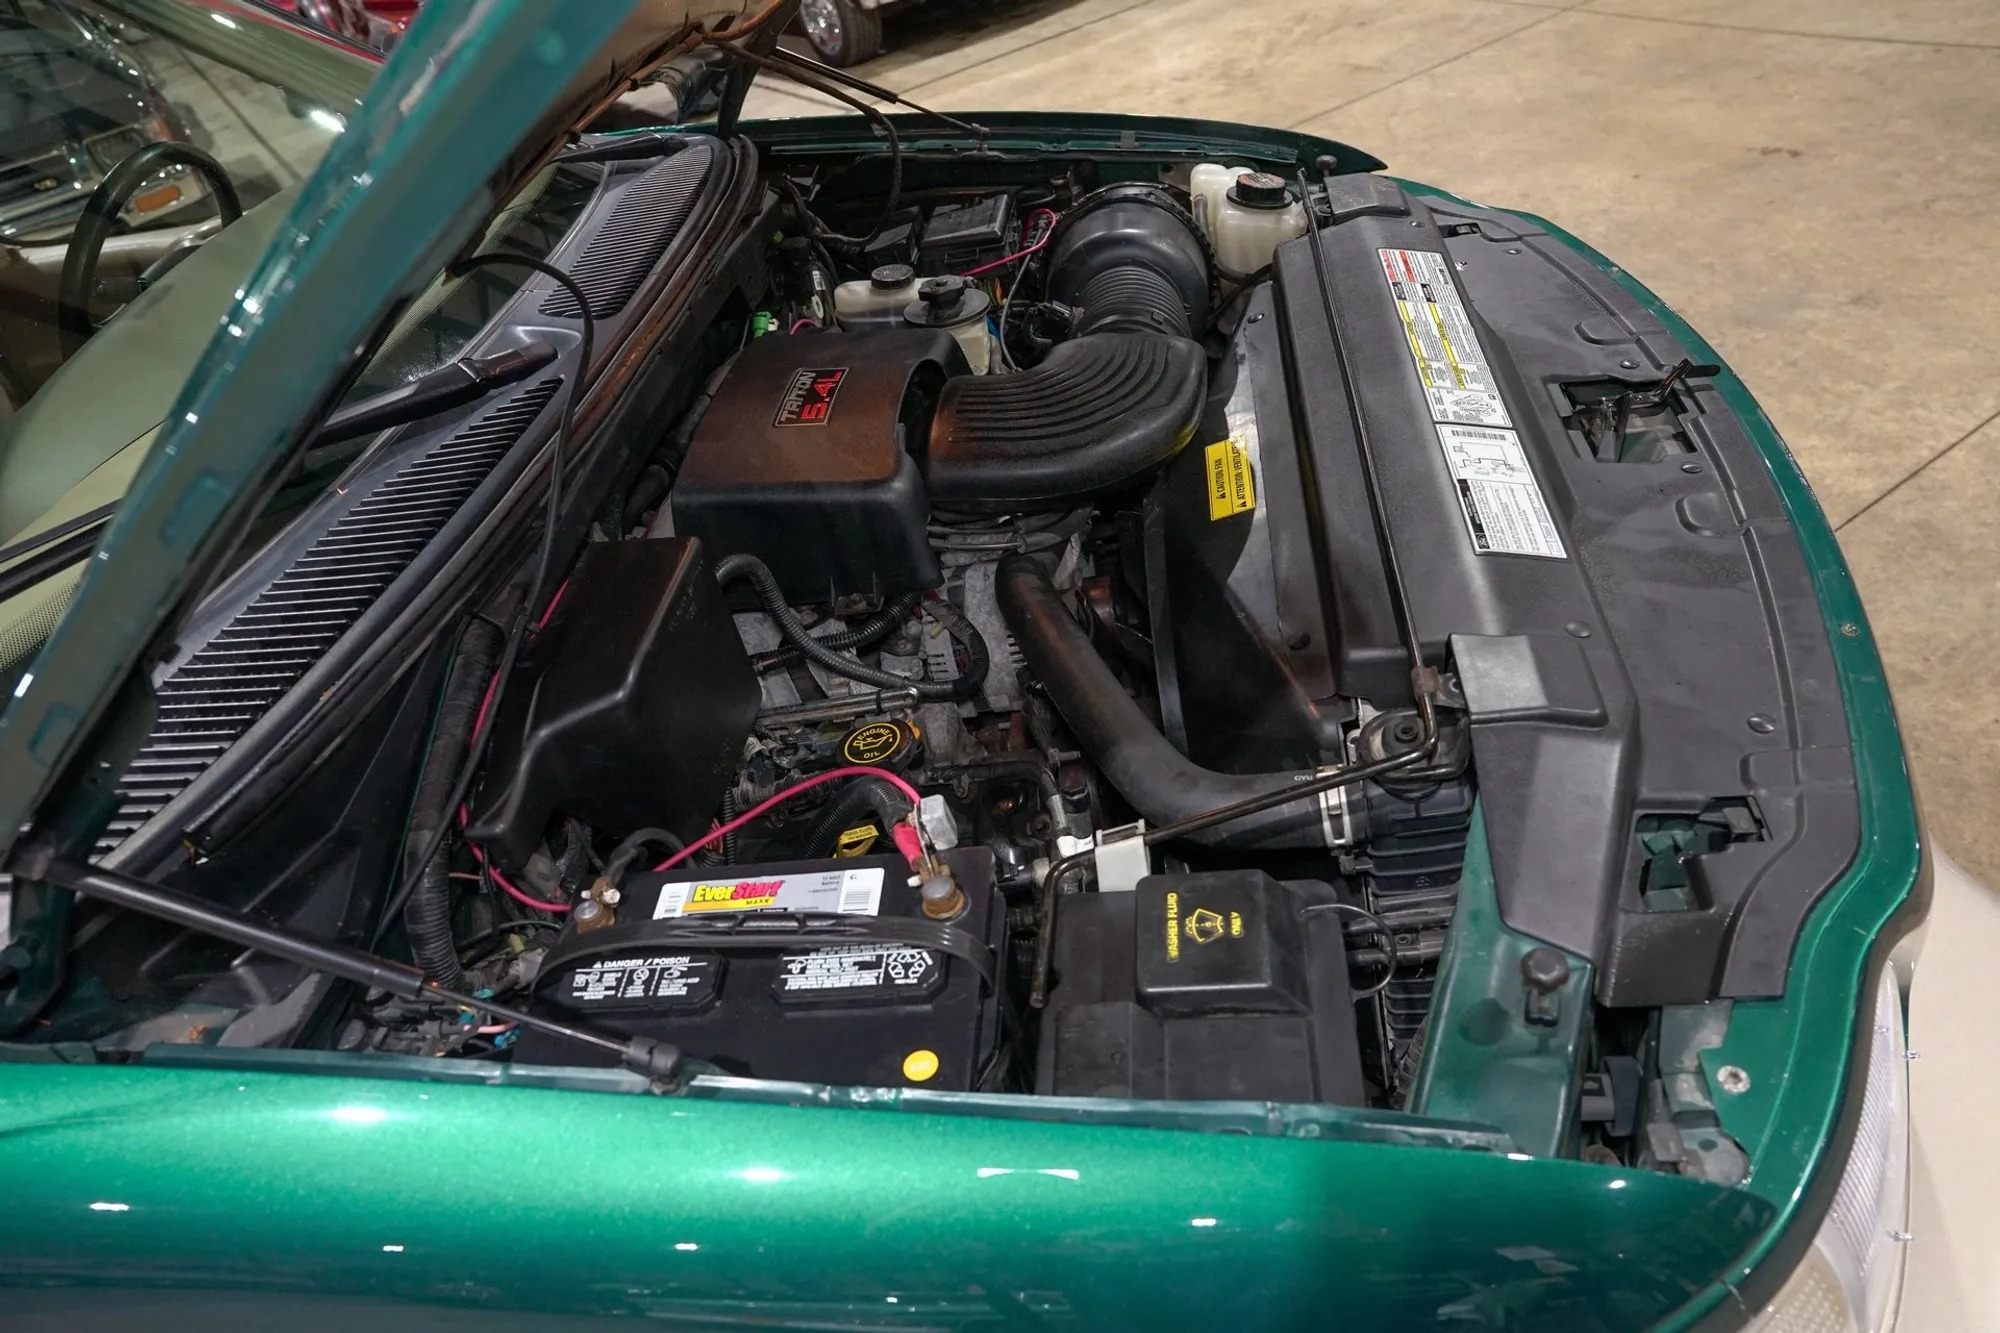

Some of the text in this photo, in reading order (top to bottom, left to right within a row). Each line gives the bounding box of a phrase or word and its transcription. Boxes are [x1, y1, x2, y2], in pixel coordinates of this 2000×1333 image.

[780, 371, 816, 421] TRITON
[800, 371, 843, 419] 5.4L
[857, 727, 891, 740] ENGINE
[692, 880, 783, 903] EverStart
[1167, 892, 1178, 918] FLUID
[1230, 911, 1242, 936] ONLY
[603, 959, 644, 968] DANGER
[652, 956, 690, 965] POISON
